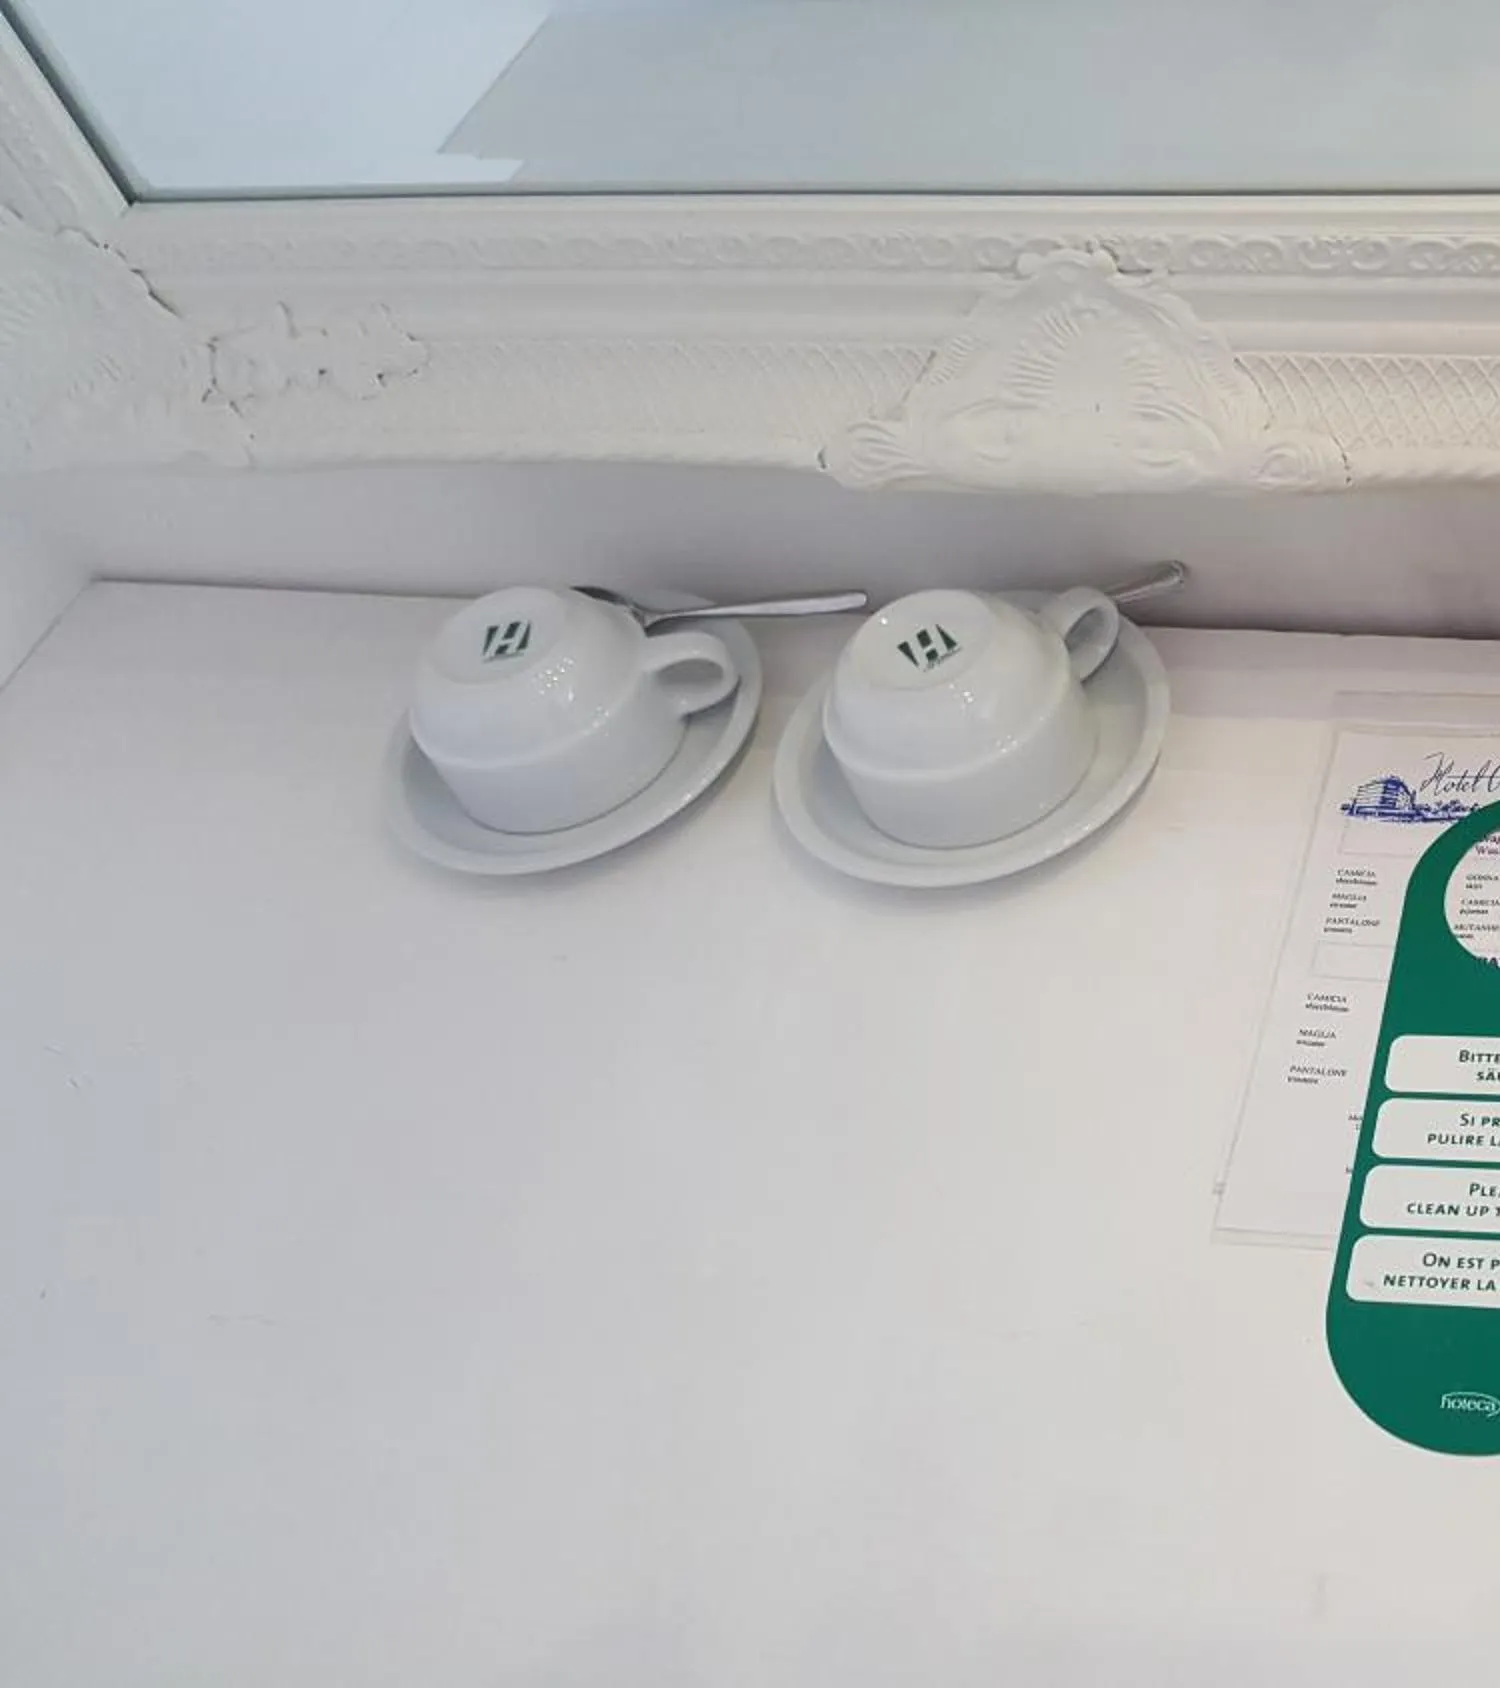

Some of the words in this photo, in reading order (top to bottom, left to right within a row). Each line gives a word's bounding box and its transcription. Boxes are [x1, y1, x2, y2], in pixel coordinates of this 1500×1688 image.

[1420, 751, 1490, 796] Hotel
[1426, 1133, 1485, 1147] PULIRE
[1406, 1202, 1460, 1217] CLEAN
[1465, 1204, 1490, 1218] UP
[1422, 1252, 1451, 1269] ON
[1456, 1257, 1485, 1271] EST
[1382, 1274, 1472, 1292] NETTOYER
[1476, 1279, 1497, 1292] LA
